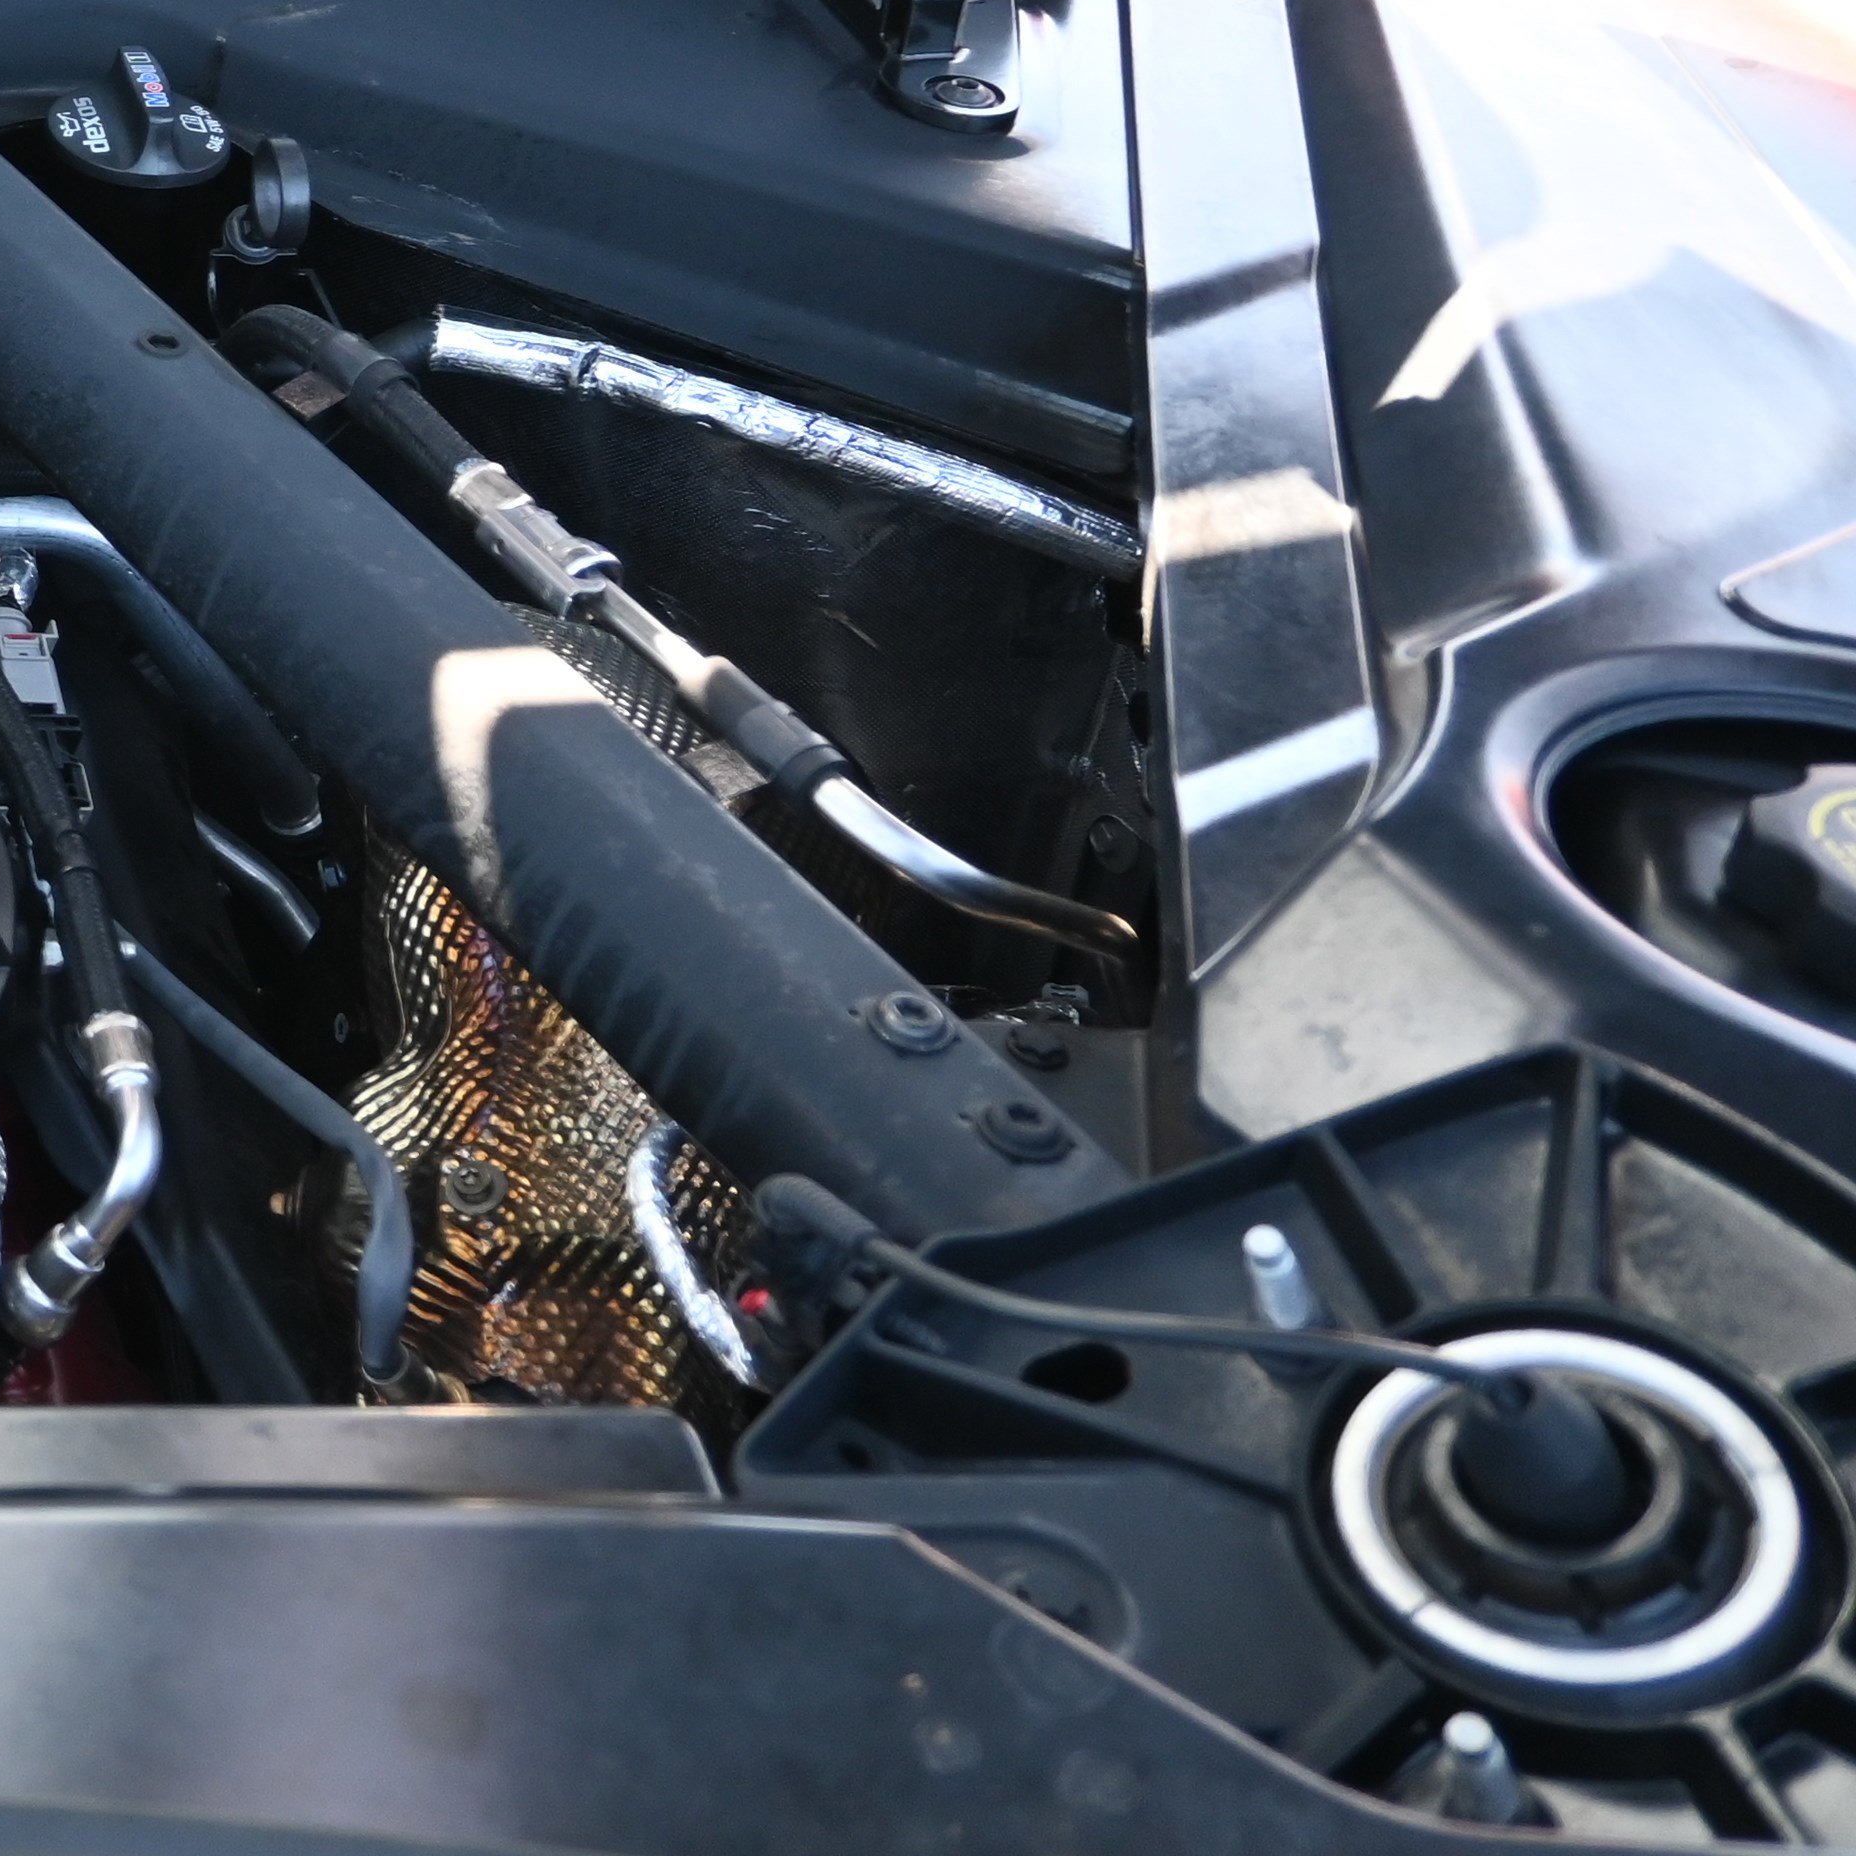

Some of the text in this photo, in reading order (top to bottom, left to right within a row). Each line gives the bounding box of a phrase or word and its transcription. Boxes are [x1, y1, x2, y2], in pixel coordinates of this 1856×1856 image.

[130, 64, 170, 107] Mobil
[73, 96, 110, 153] dexos
[206, 135, 225, 152] SAE
